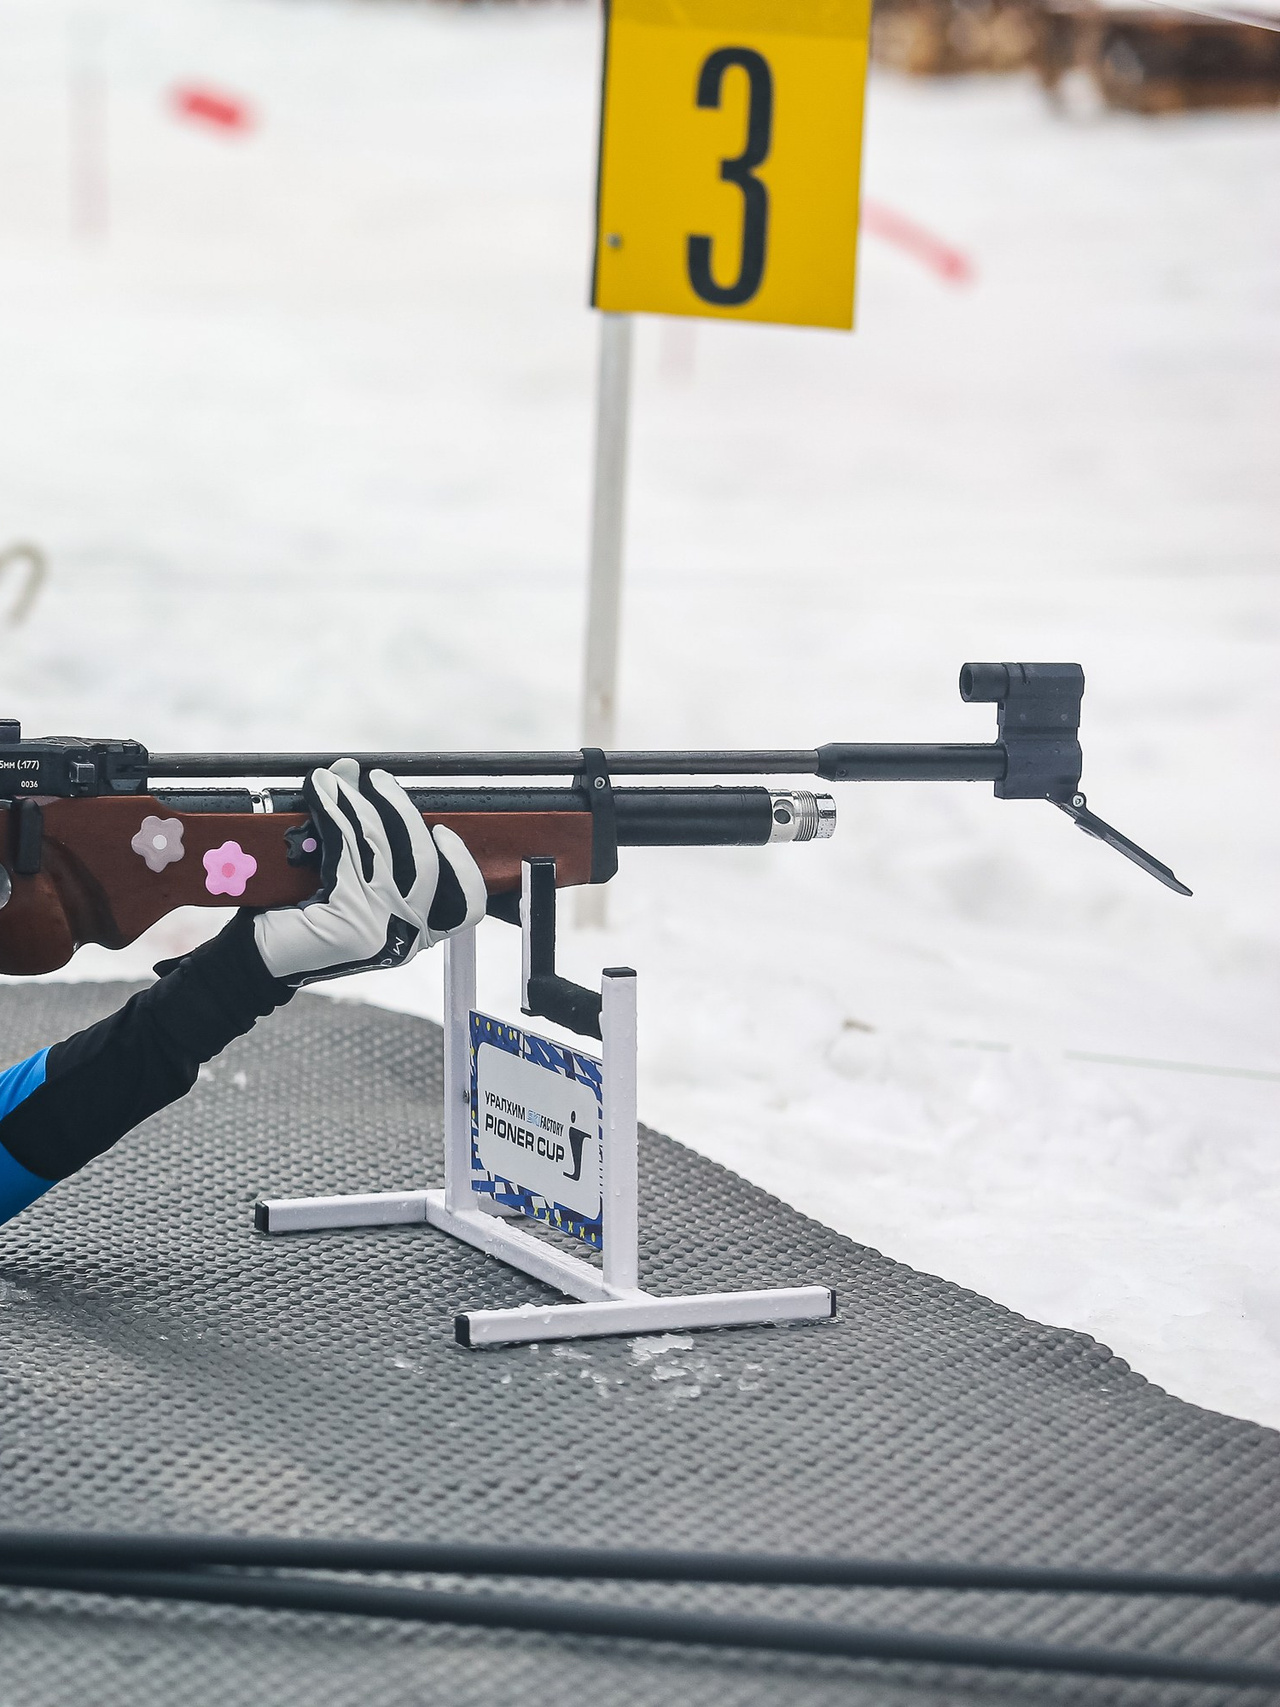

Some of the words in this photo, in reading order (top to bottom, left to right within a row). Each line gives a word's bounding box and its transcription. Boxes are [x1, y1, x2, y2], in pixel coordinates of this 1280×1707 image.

[686, 46, 774, 308] 3
[20, 780, 38, 788] 0036
[484, 1090, 525, 1121] УРАЛХИМ
[485, 1113, 534, 1151] PIONER
[537, 1136, 564, 1162] CUP
